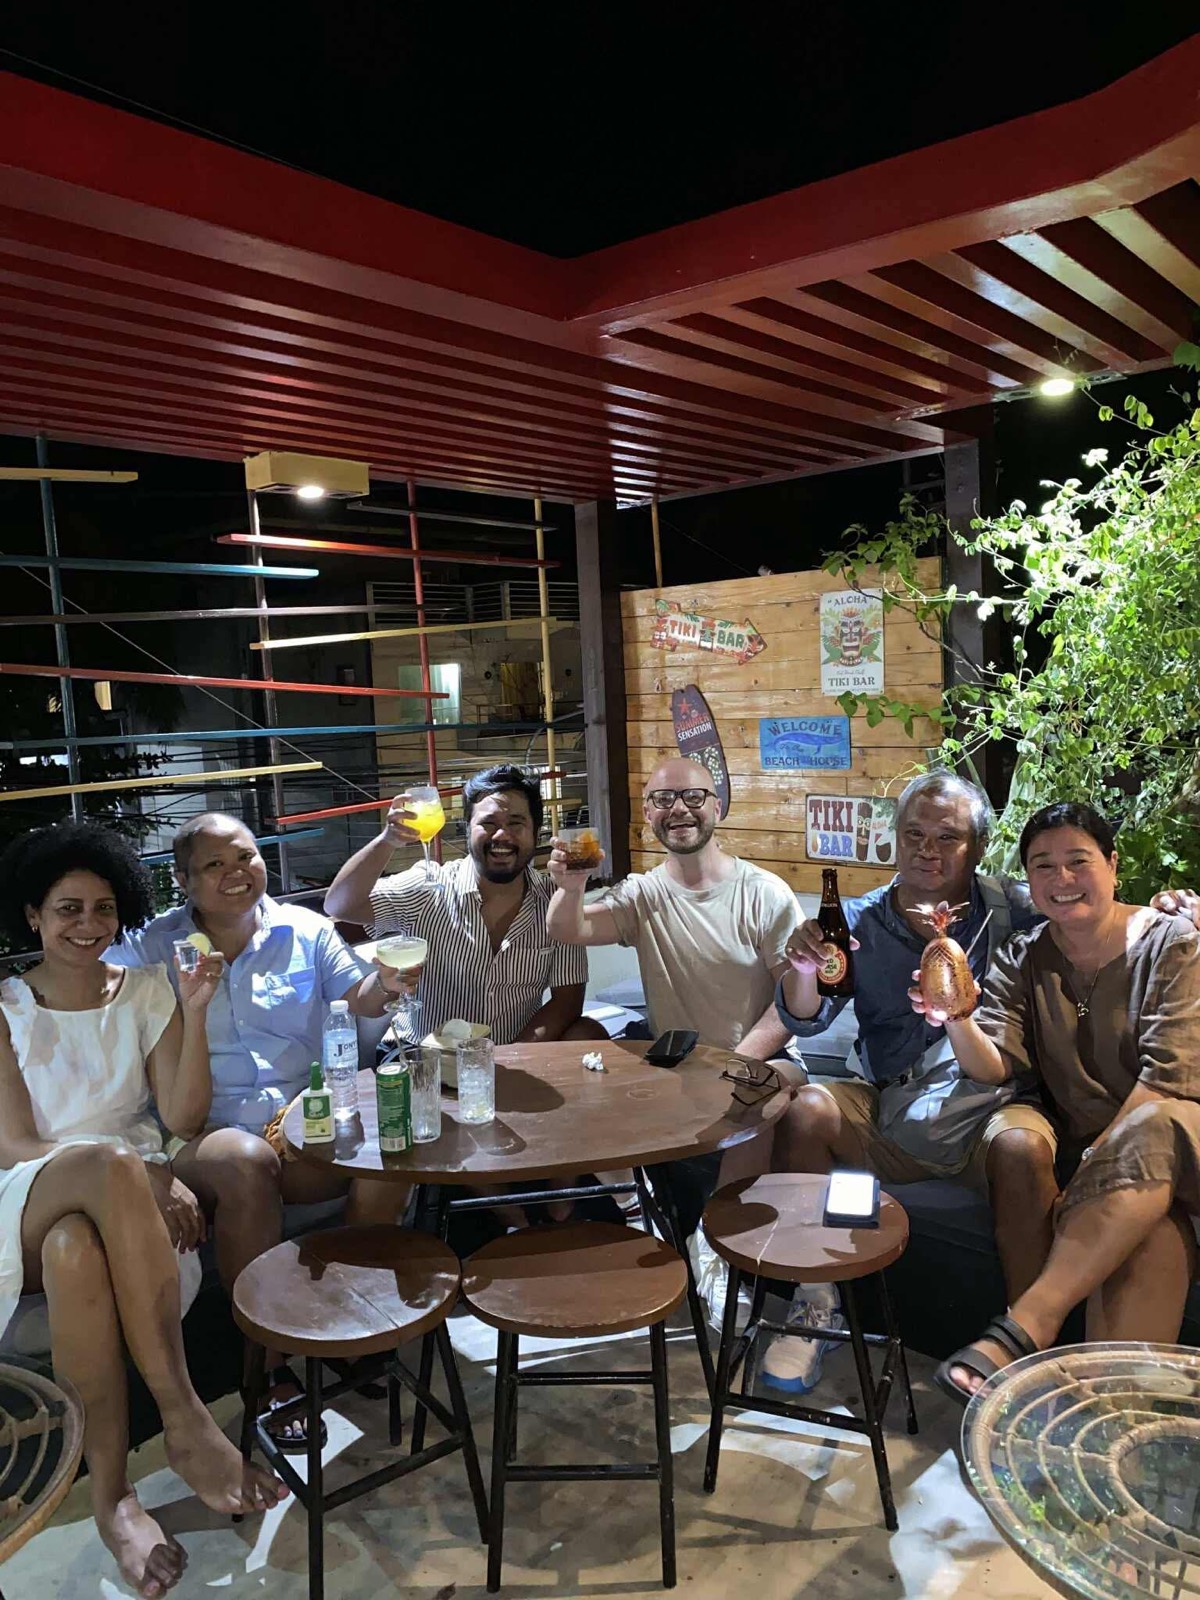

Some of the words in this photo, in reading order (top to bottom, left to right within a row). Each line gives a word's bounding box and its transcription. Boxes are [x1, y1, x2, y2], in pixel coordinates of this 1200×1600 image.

[669, 619, 697, 638] TIKI
[717, 629, 745, 649] BAR
[828, 678, 850, 687] TIKI
[853, 676, 875, 685] BAR
[677, 721, 713, 742] SENSATION
[768, 721, 842, 736] WELCOME
[765, 757, 800, 766] BEACH
[810, 757, 848, 766] HOUSE
[809, 800, 853, 832] TIKI
[819, 833, 853, 857] BAR
